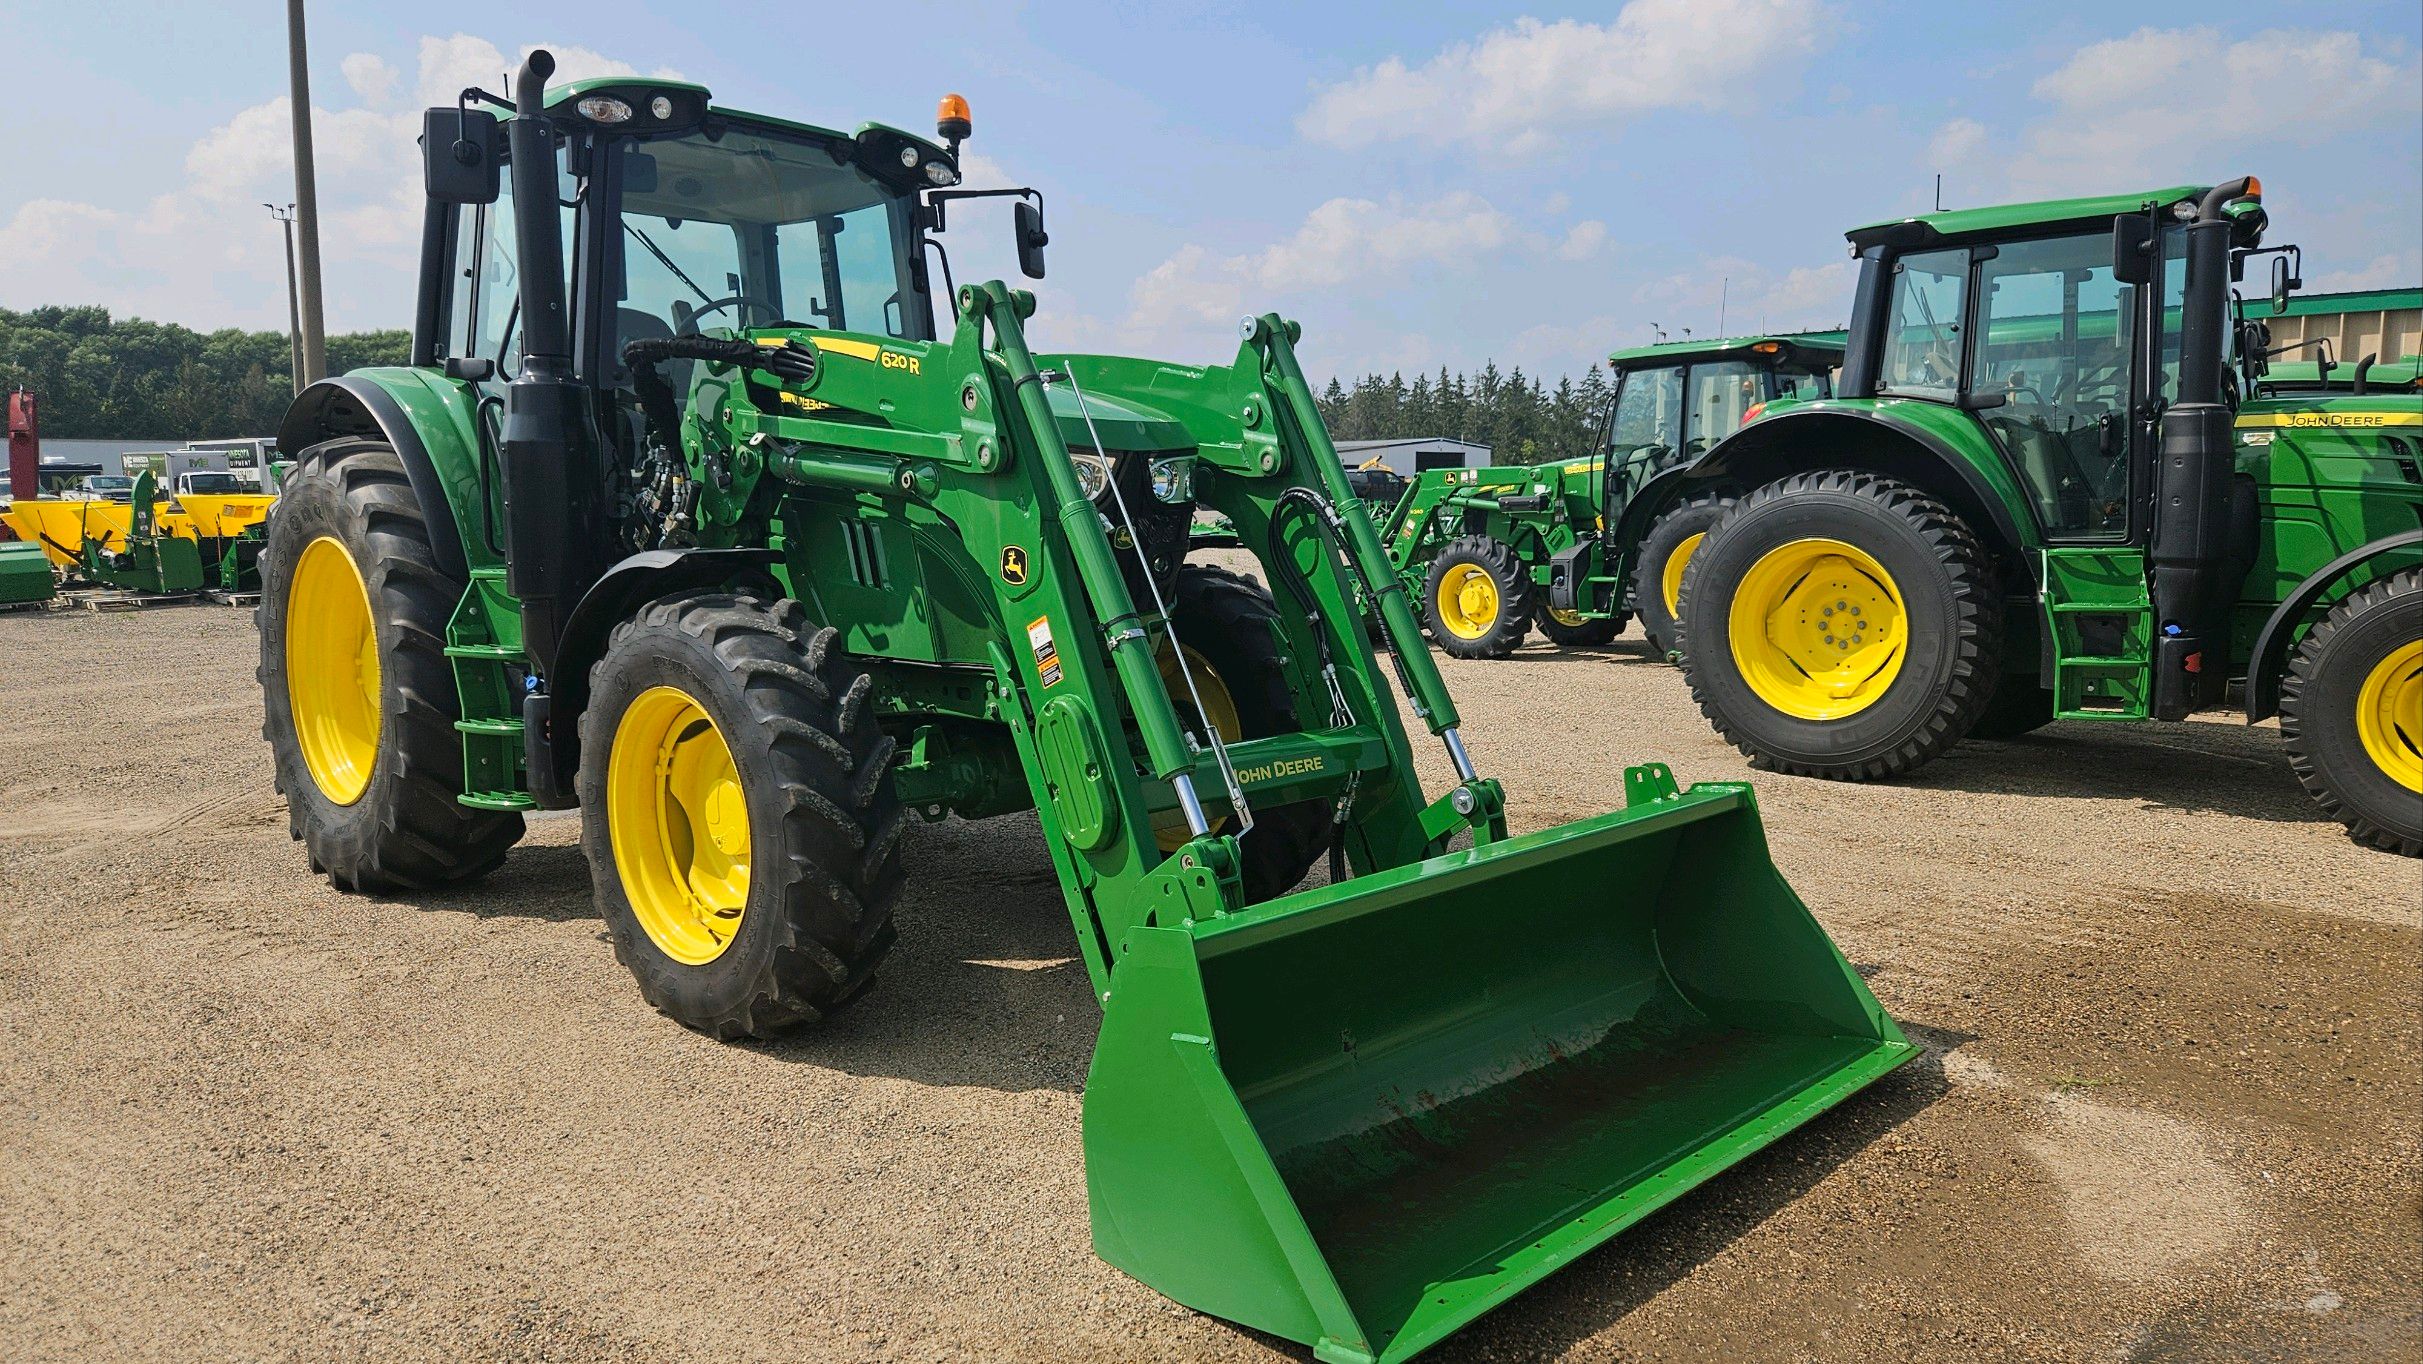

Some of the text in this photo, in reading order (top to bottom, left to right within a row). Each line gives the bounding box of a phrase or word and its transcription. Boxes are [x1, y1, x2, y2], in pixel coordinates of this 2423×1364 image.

[881, 351, 920, 375] 620 R
[2287, 415, 2384, 426] JOHN DEERE
[1273, 757, 1324, 778] DEERE
